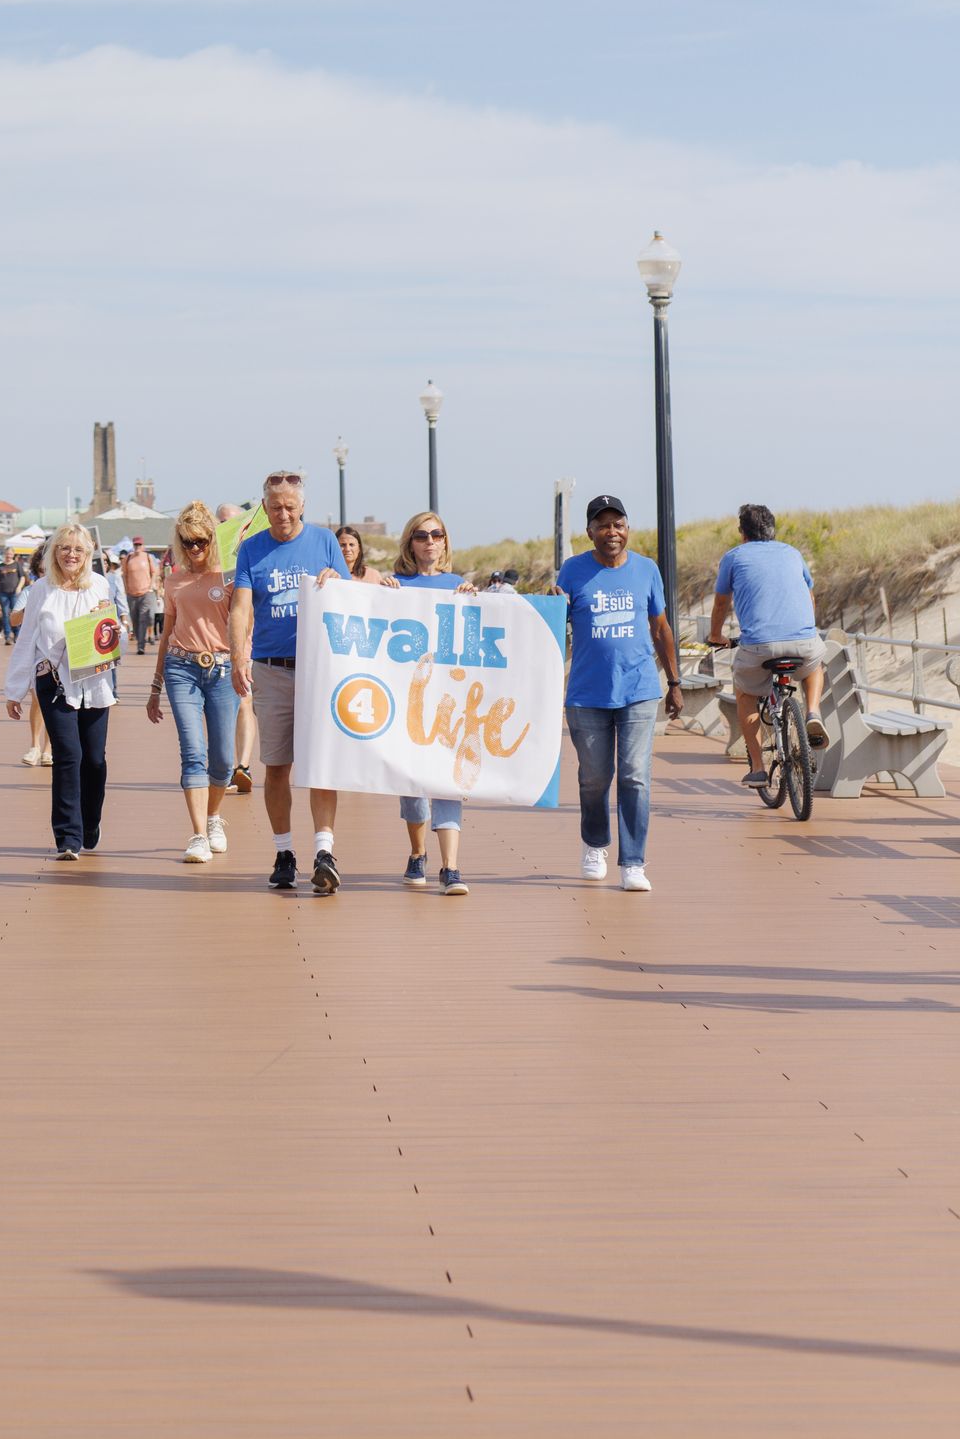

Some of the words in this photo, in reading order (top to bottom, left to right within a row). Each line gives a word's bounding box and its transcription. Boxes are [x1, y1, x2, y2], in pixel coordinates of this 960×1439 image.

[267, 568, 308, 592] JESU
[271, 606, 287, 619] MY
[590, 590, 633, 613] JESUS
[323, 603, 507, 668] walk
[591, 626, 609, 639] MY
[611, 625, 634, 638] LIFE
[348, 688, 375, 723] 4
[406, 652, 530, 791] life
